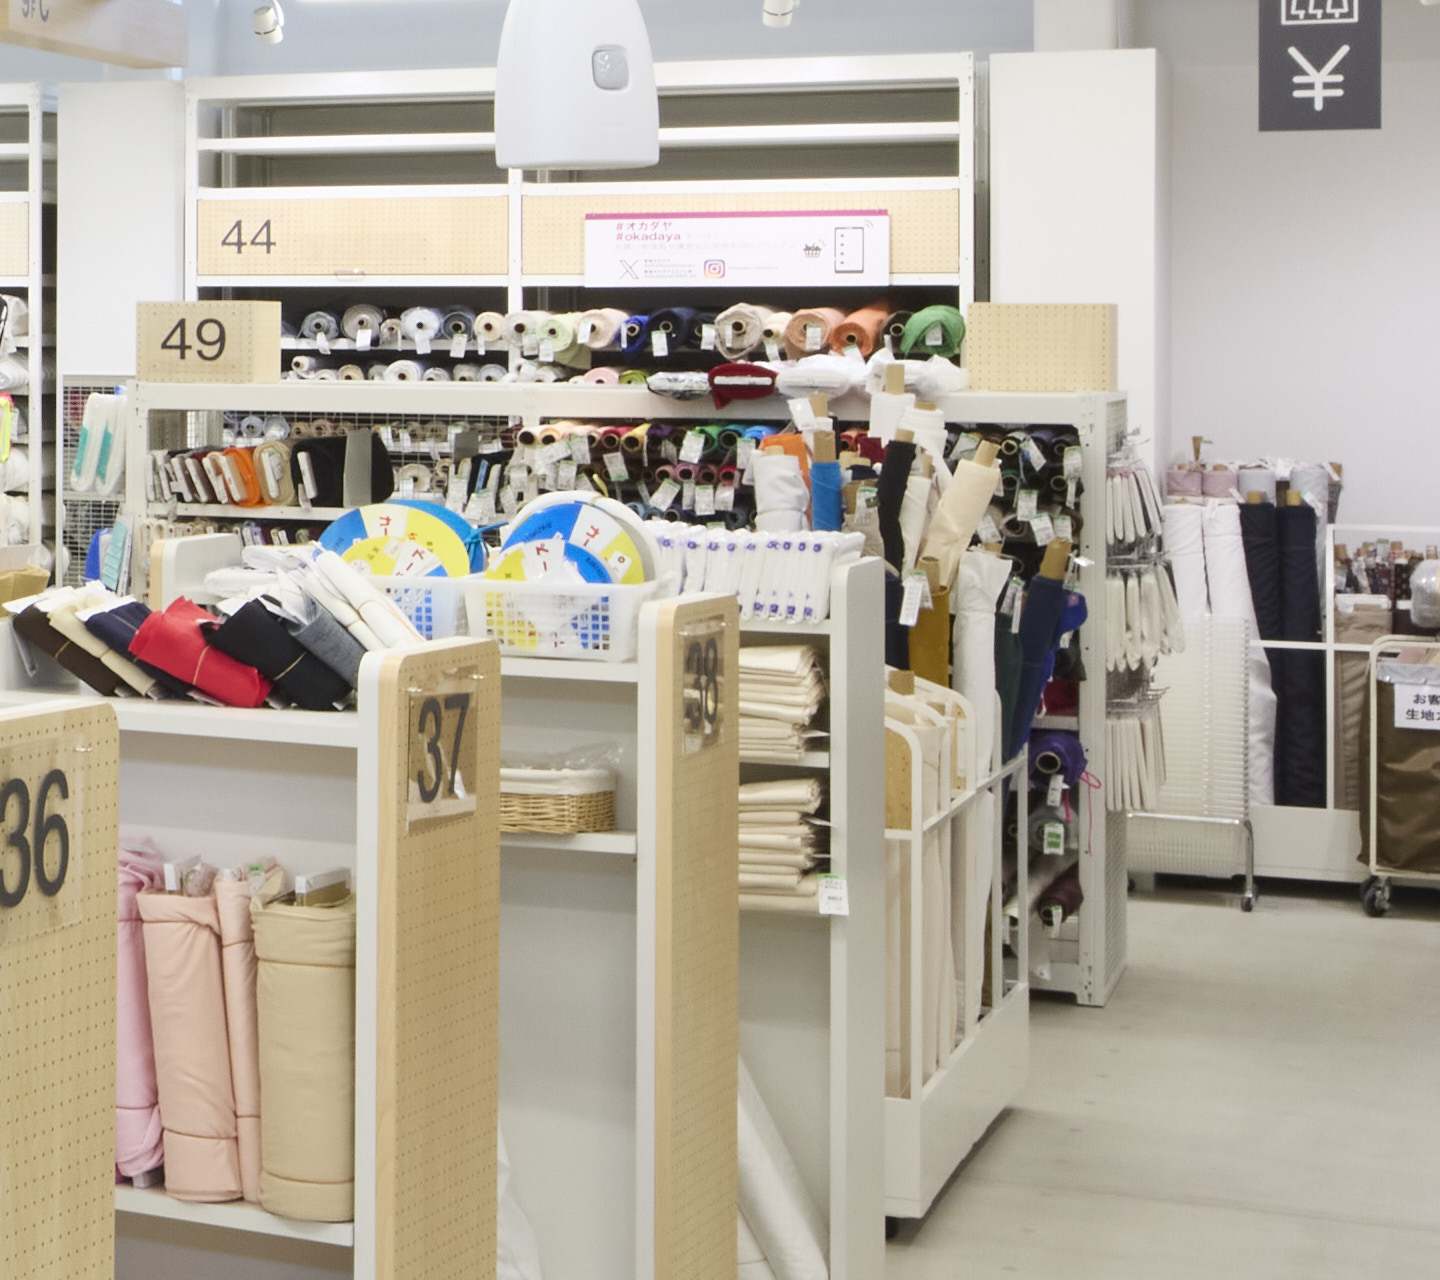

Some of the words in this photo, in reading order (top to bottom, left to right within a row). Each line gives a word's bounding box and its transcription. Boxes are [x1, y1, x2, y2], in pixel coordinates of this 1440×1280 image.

[221, 218, 276, 254] 44
[616, 231, 682, 242] #okadaya
[161, 318, 226, 361] 49
[417, 692, 470, 803] 37
